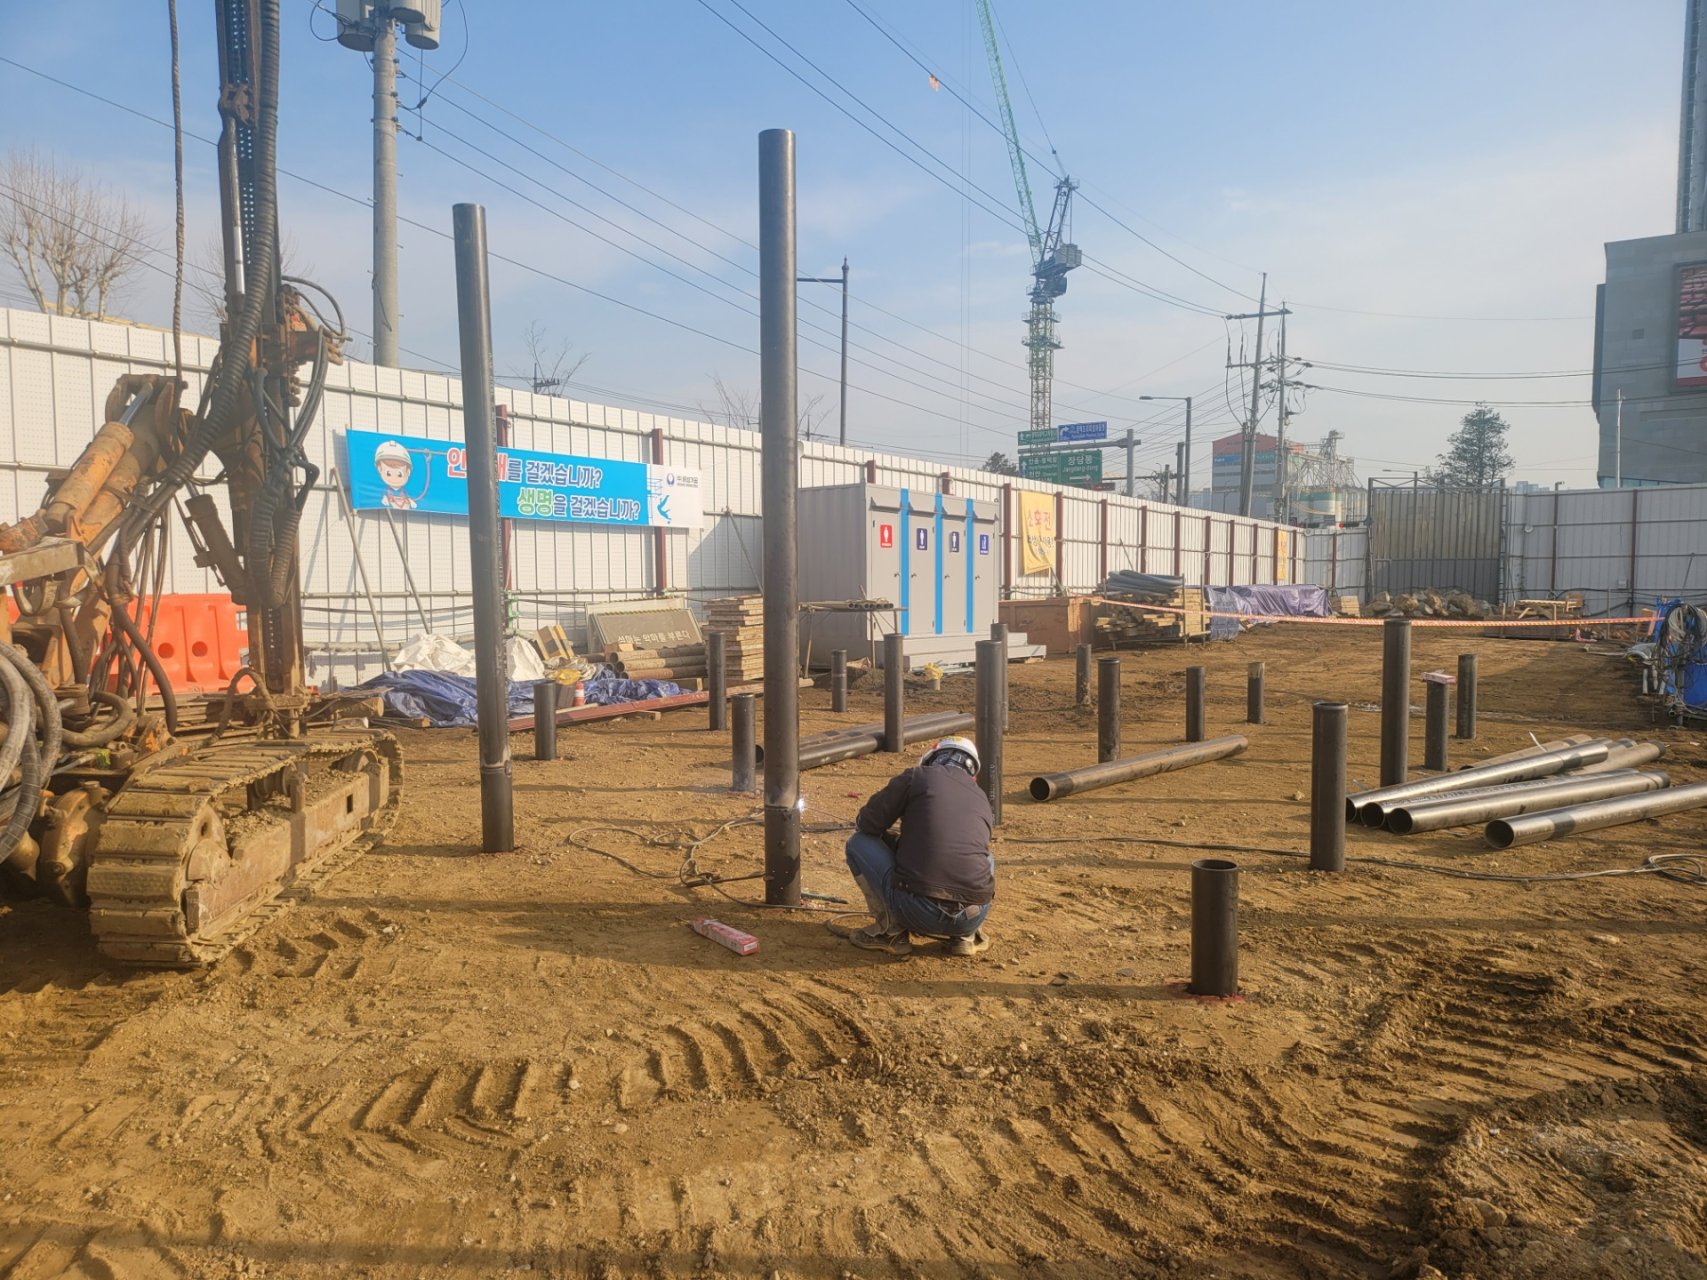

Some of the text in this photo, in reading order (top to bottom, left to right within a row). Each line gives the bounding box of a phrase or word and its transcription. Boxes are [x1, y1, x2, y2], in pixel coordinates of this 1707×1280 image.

[447, 448, 602, 488] 안를 걸겠습니까?
[517, 487, 640, 520] 생명을 걸겠습니까?
